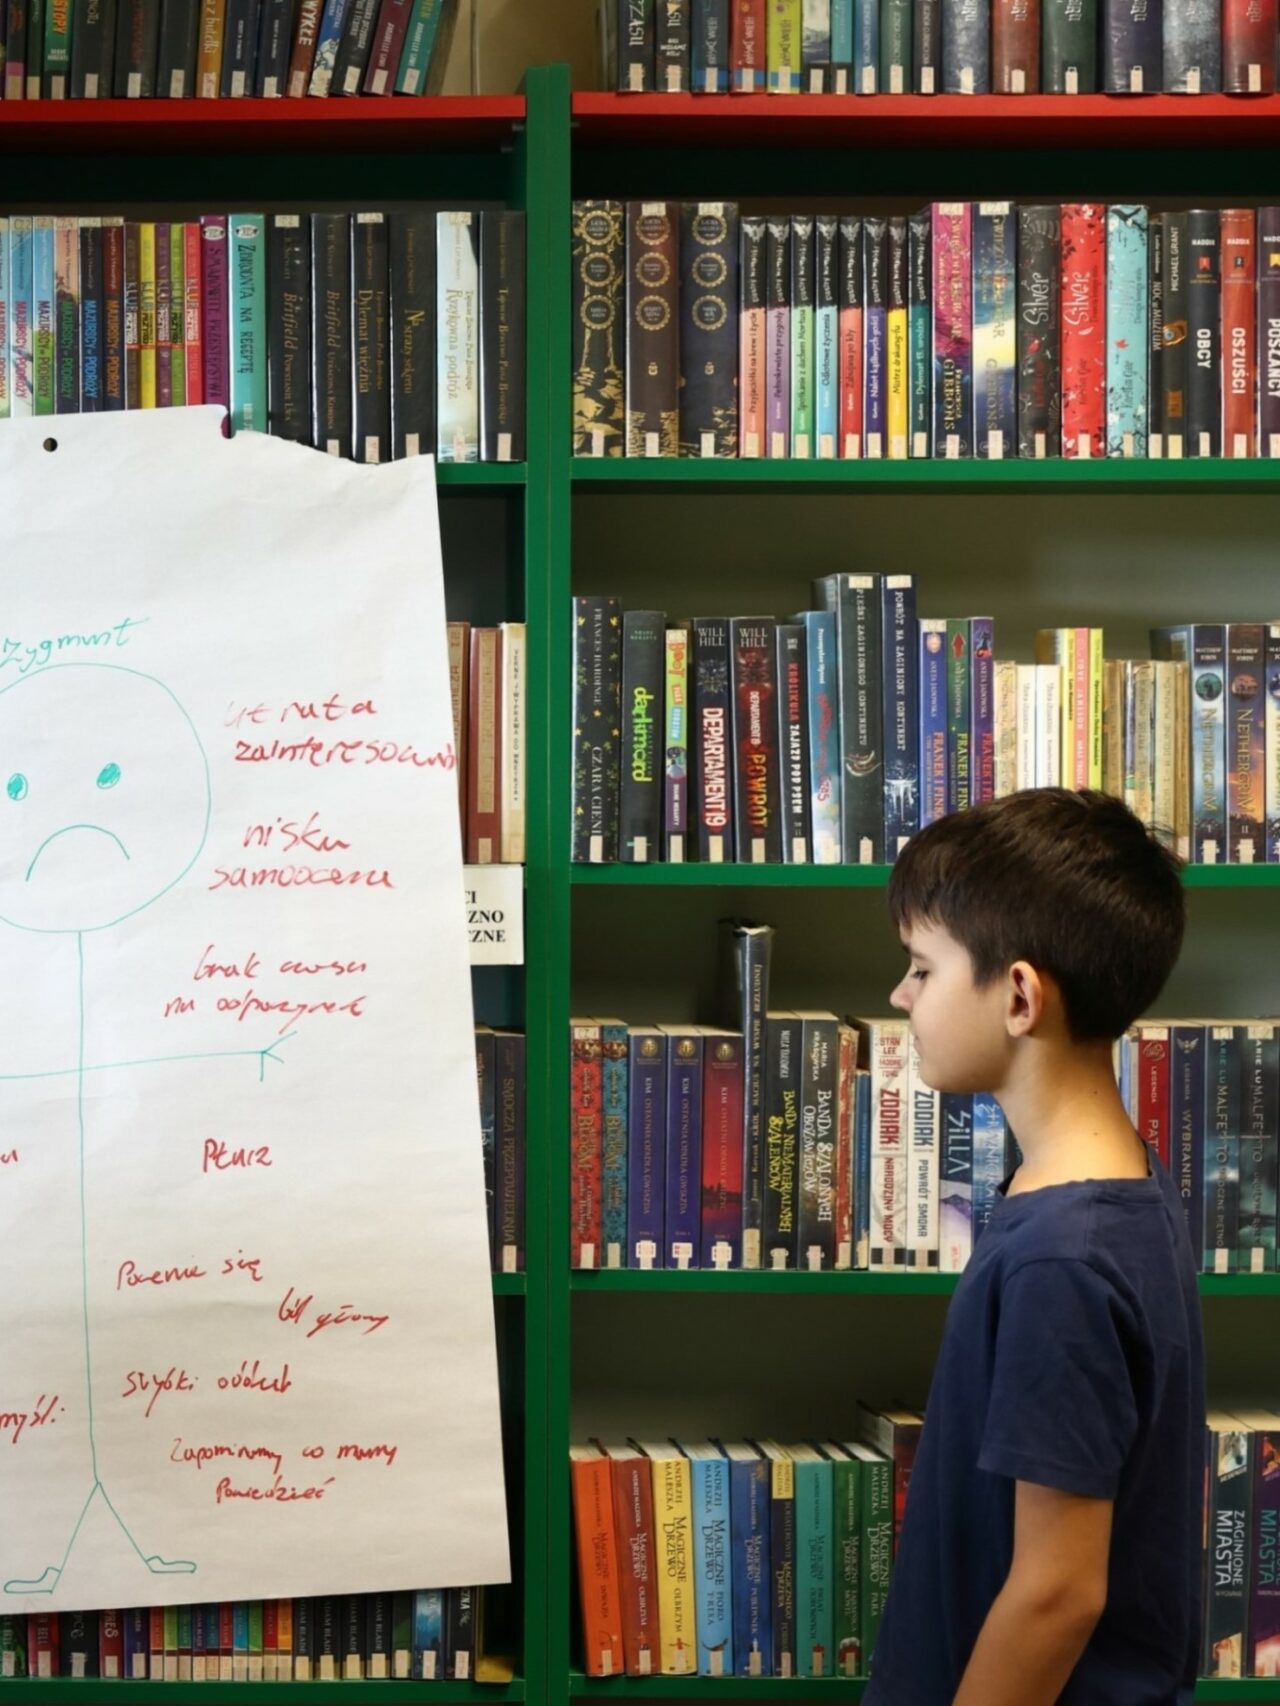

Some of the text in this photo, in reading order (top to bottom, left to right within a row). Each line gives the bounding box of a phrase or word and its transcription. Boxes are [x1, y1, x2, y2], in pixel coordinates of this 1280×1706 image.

[1170, 227, 1179, 291] MICHAEL GRANT
[84, 300, 96, 348] MAZURSCY
[239, 307, 250, 323] NA
[324, 290, 341, 347] Britfield
[237, 331, 251, 374] RECEPTĘ
[354, 290, 374, 393] Dylemat więźnia
[1196, 329, 1210, 368] OBCY
[1231, 328, 1247, 394] OSZUŚCI
[0, 617, 150, 673] Zygmunt
[696, 628, 724, 637] WILL
[698, 638, 724, 647] HILL
[895, 592, 906, 751] POWRÓT NA ZAGINIONY KONTYNENT
[789, 724, 801, 761] ZAJAZD
[1237, 709, 1253, 815] NETHERGRIM
[591, 746, 603, 794] CZARA
[702, 708, 726, 827] DEPARTAMENT 19
[747, 754, 771, 828] POWRÓT
[789, 764, 800, 784] POD
[789, 786, 801, 814] PSEM
[468, 910, 504, 924] ZNO
[193, 944, 261, 981] brak
[783, 1090, 796, 1129] BANDA
[817, 1090, 831, 1137] BANDA
[880, 1088, 900, 1145] ZODIAK
[913, 1090, 934, 1146] ZODIAK
[883, 1157, 894, 1243] NARODZINY MOCY
[917, 1159, 929, 1237] POWRÓT SMOKA
[222, 1249, 264, 1282] się
[302, 1446, 325, 1459] co
[665, 1462, 674, 1512] MALESZKA
[673, 1461, 683, 1504] ANDRZEJ
[662, 1523, 677, 1578] DRZEWO
[673, 1516, 687, 1583] MAGICZNE
[1215, 1510, 1233, 1586] MIASTA
[1233, 1510, 1245, 1586] ZAGINIONE
[673, 1588, 683, 1633] OLBRZYM
